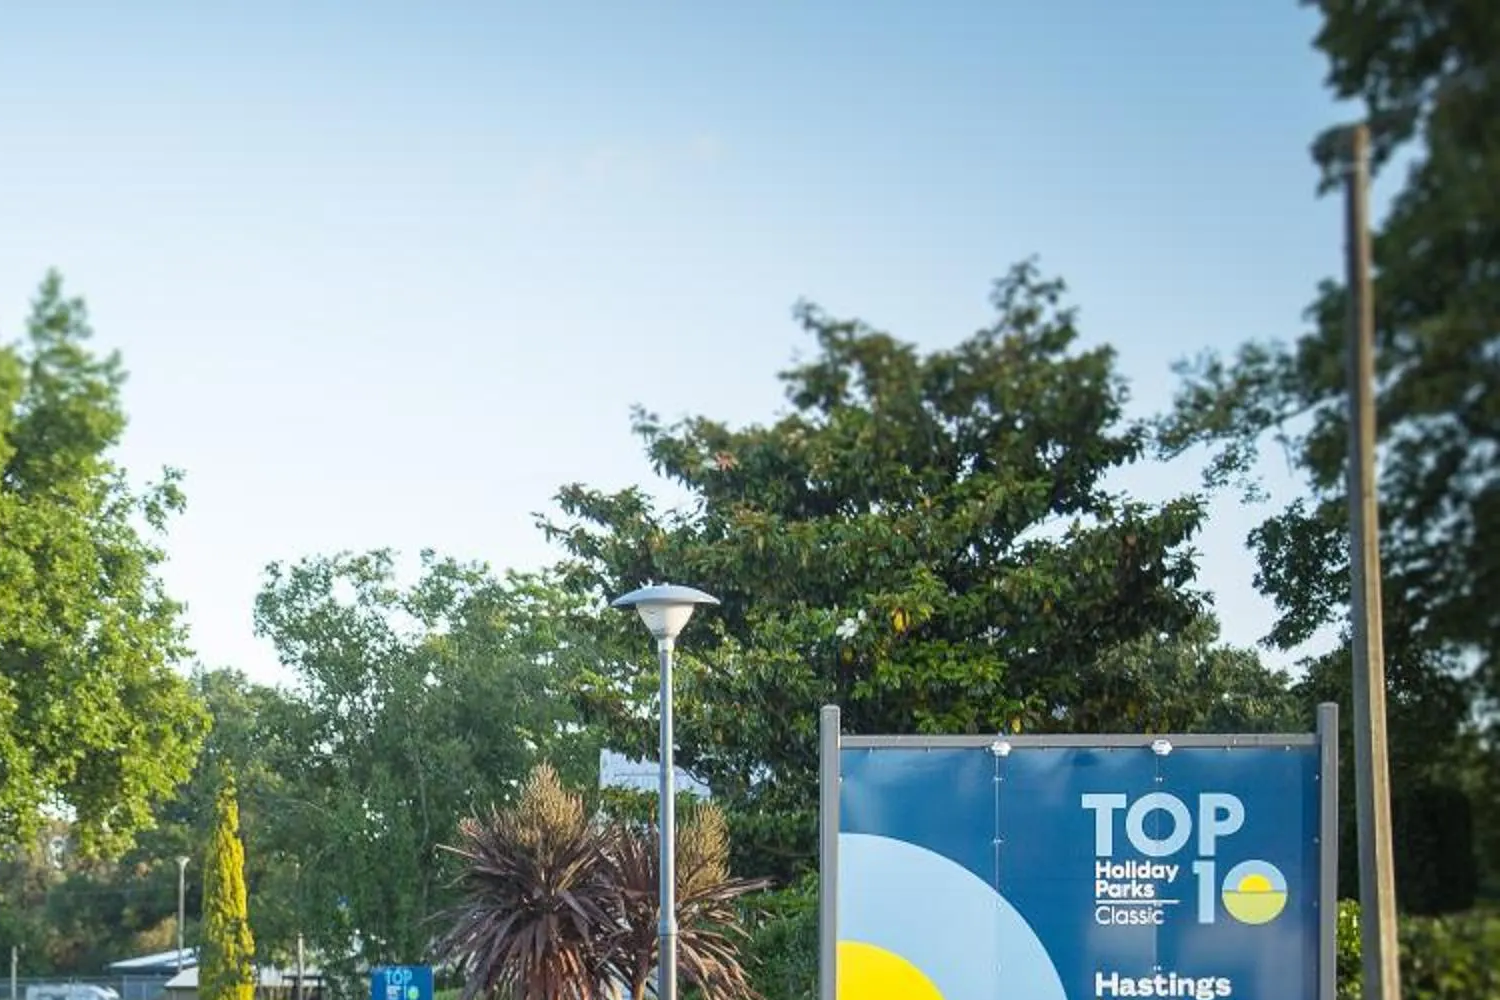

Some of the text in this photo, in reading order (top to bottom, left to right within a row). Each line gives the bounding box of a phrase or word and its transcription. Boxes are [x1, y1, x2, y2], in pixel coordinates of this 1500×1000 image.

[1082, 791, 1245, 857] TOP
[1095, 860, 1179, 883] Holiday
[1095, 879, 1155, 898] Parks
[1192, 859, 1288, 925] 10
[1095, 905, 1165, 925] Classic
[384, 967, 413, 985] TOP
